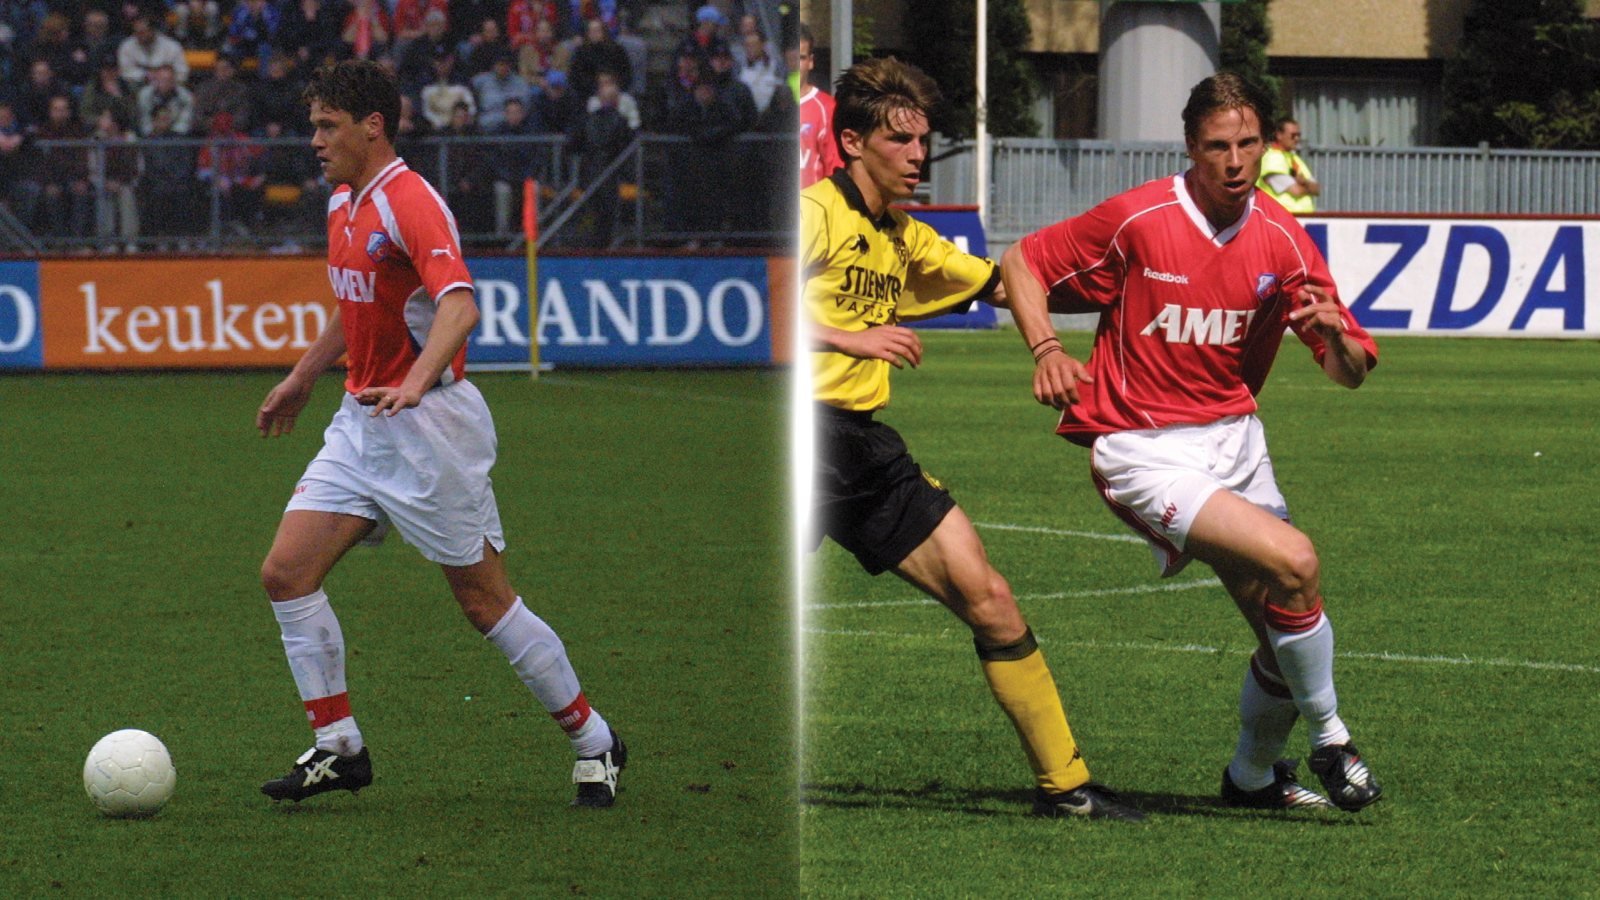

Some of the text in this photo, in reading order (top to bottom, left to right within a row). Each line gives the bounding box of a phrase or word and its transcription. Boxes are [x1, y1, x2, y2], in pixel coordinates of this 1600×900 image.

[327, 264, 376, 302] MEV
[1143, 267, 1189, 285] Reebok
[79, 280, 328, 353] keuken
